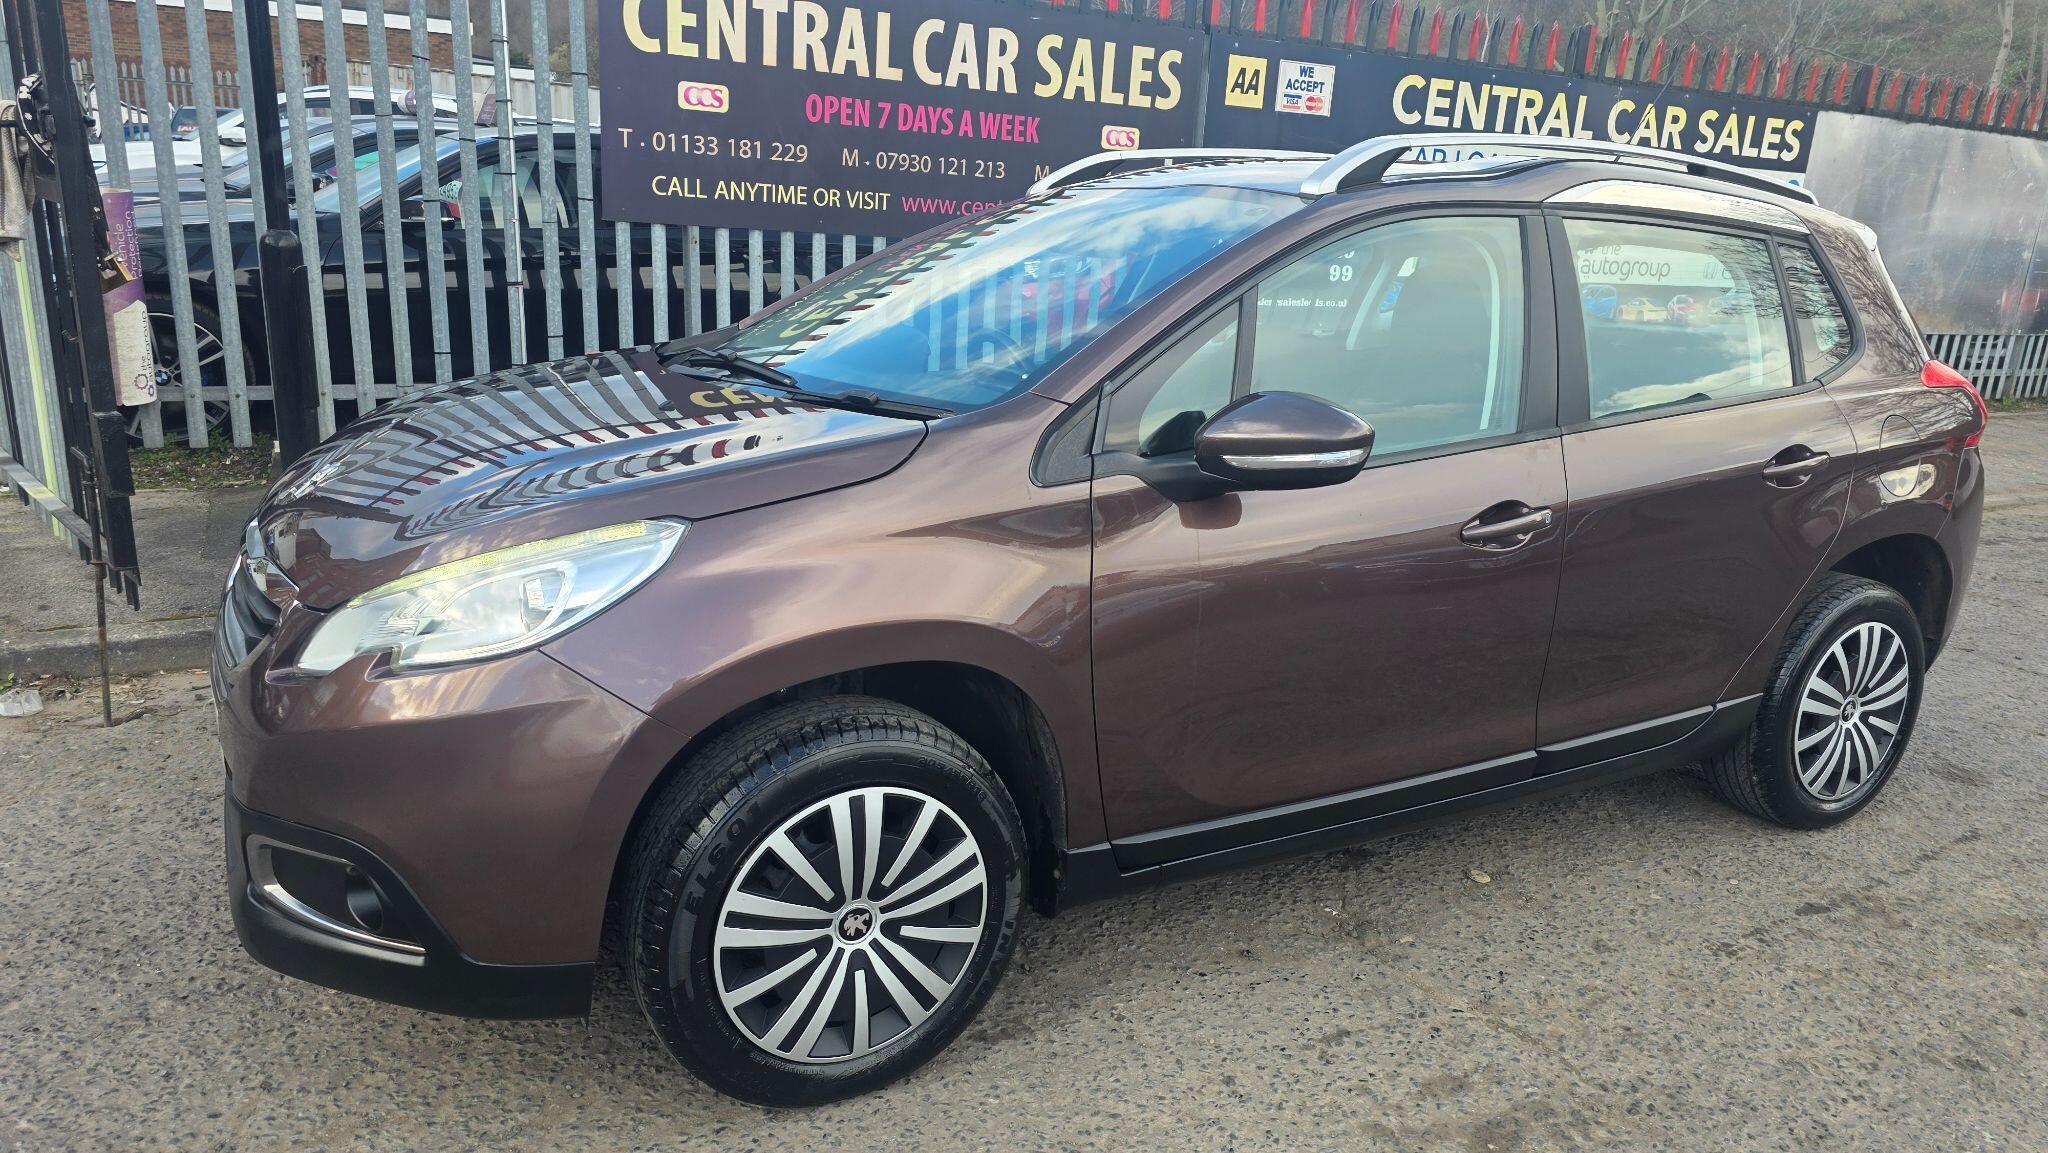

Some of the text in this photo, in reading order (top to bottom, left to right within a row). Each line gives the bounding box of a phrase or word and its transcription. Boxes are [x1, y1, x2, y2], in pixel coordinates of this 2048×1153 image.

[622, 0, 1183, 110] CENTRAL CAR SALES
[1230, 67, 1261, 96] AA
[1285, 78, 1326, 94] ACCEPT
[1299, 65, 1315, 79] WE
[1286, 97, 1299, 106] VISA
[805, 93, 1041, 144] OPEN 7 DAYS A WEEK
[1392, 74, 1805, 162] CENTRAL CAR SALES
[652, 131, 719, 156] 01133
[728, 138, 761, 160] 181
[769, 142, 808, 163] 229
[876, 151, 932, 174] 07930
[938, 156, 967, 177] 121
[974, 159, 1006, 179] 213
[651, 175, 891, 211] CALL ANYTIME OR VISIT
[1329, 264, 1353, 282] 99
[1580, 256, 1672, 282] autogroup
